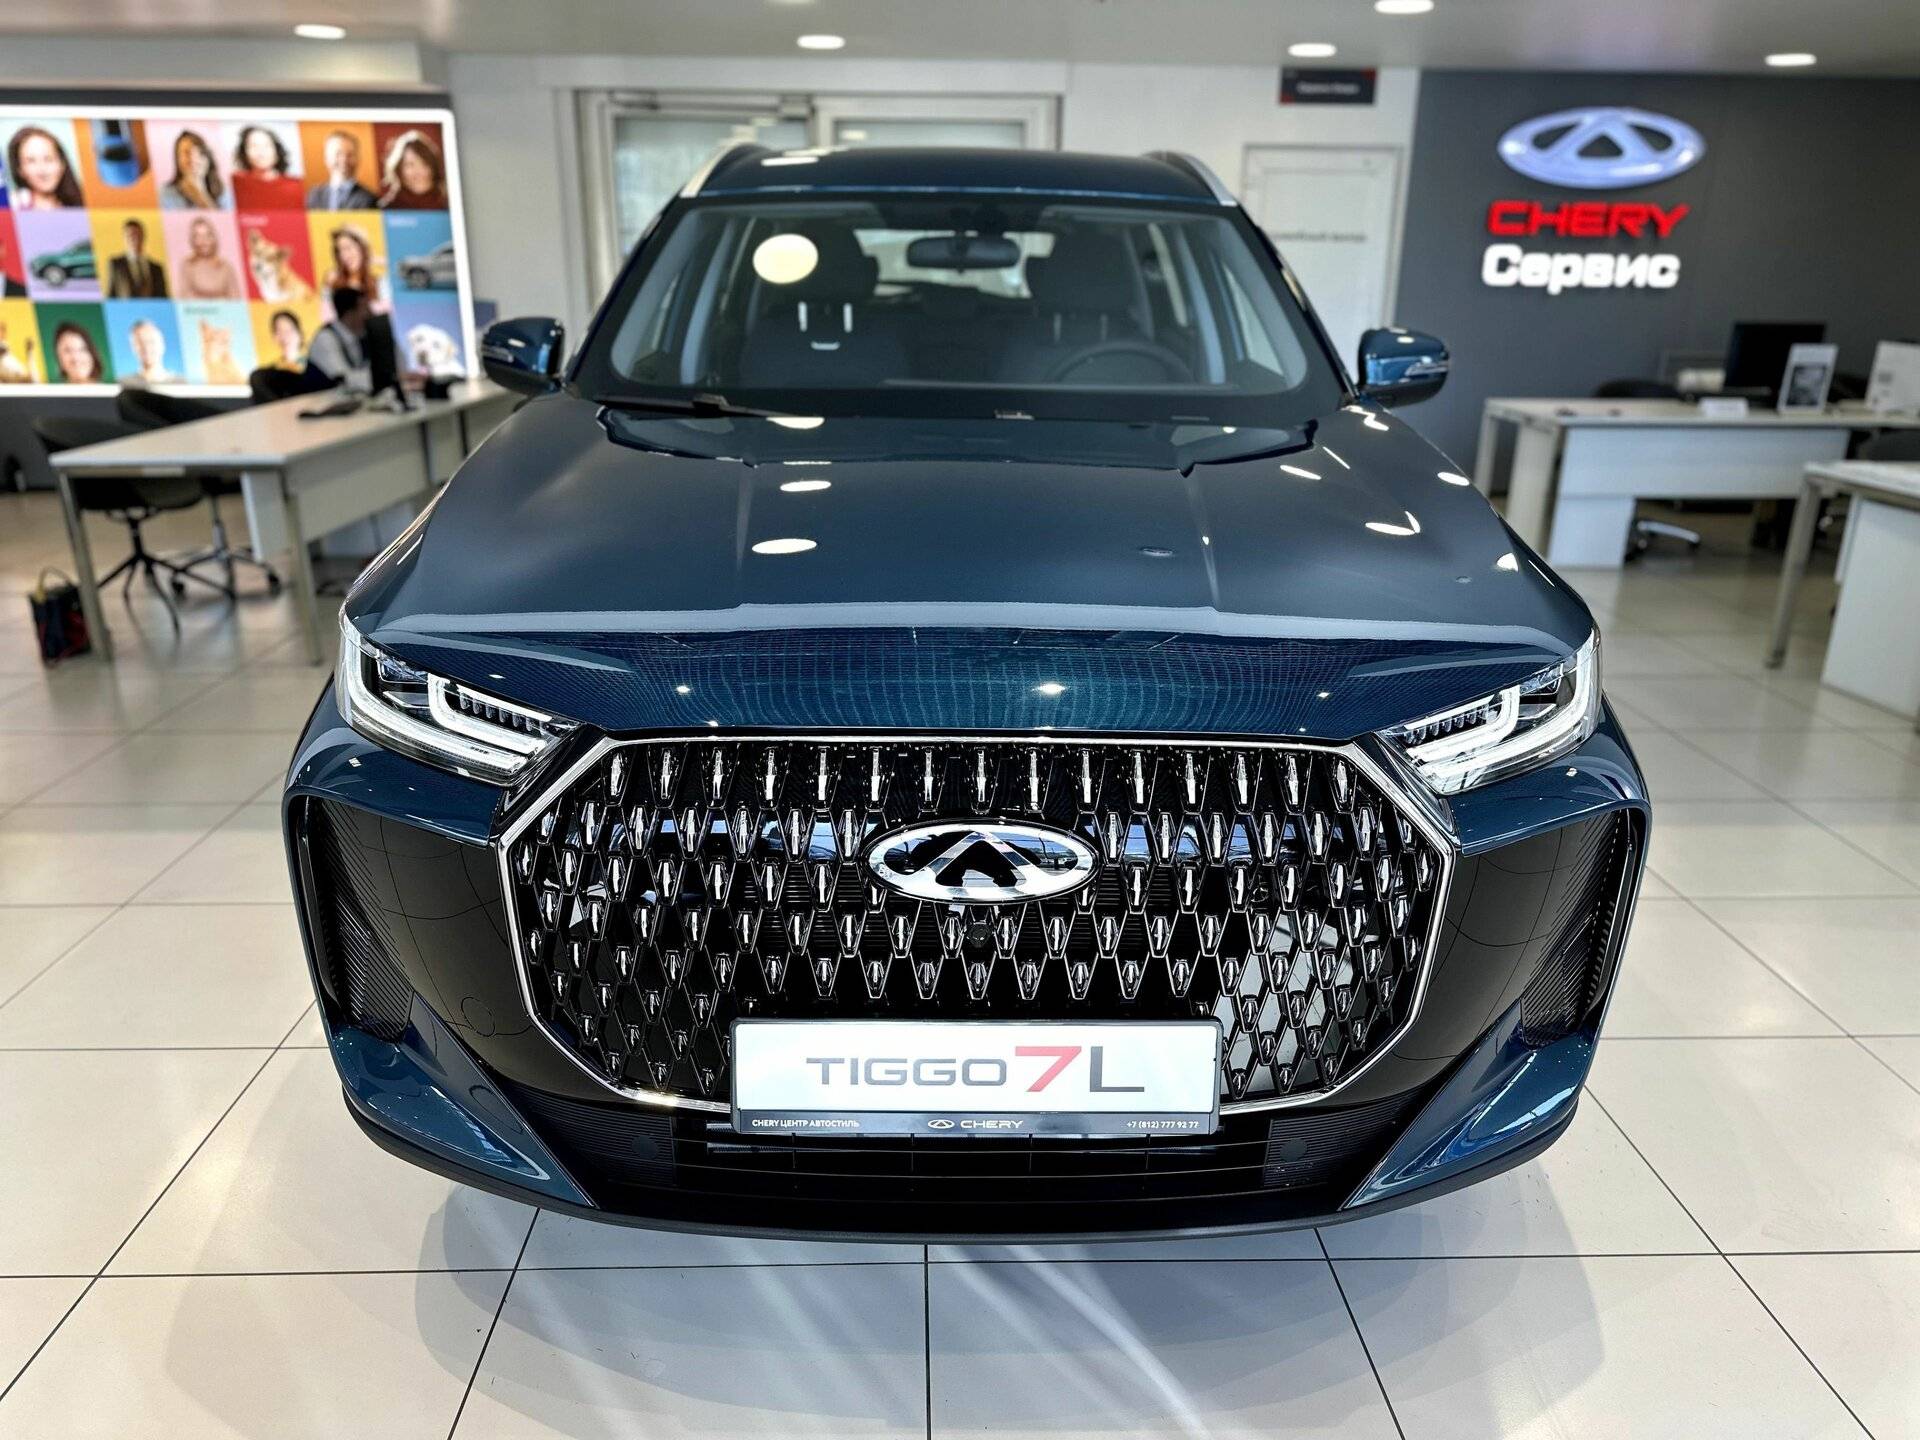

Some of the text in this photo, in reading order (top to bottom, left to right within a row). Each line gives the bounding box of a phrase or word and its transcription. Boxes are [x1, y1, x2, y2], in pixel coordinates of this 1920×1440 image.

[1486, 200, 1690, 238] CHERY
[1482, 244, 1681, 294] Сервис
[806, 1057, 1007, 1087] TIGGO
[752, 1120, 861, 1130] CHERY ЦЕНТР АВТОСТИЛЬ
[960, 1119, 1024, 1129] CHERY
[1126, 1120, 1199, 1130] +7 (812) 777 92 77
